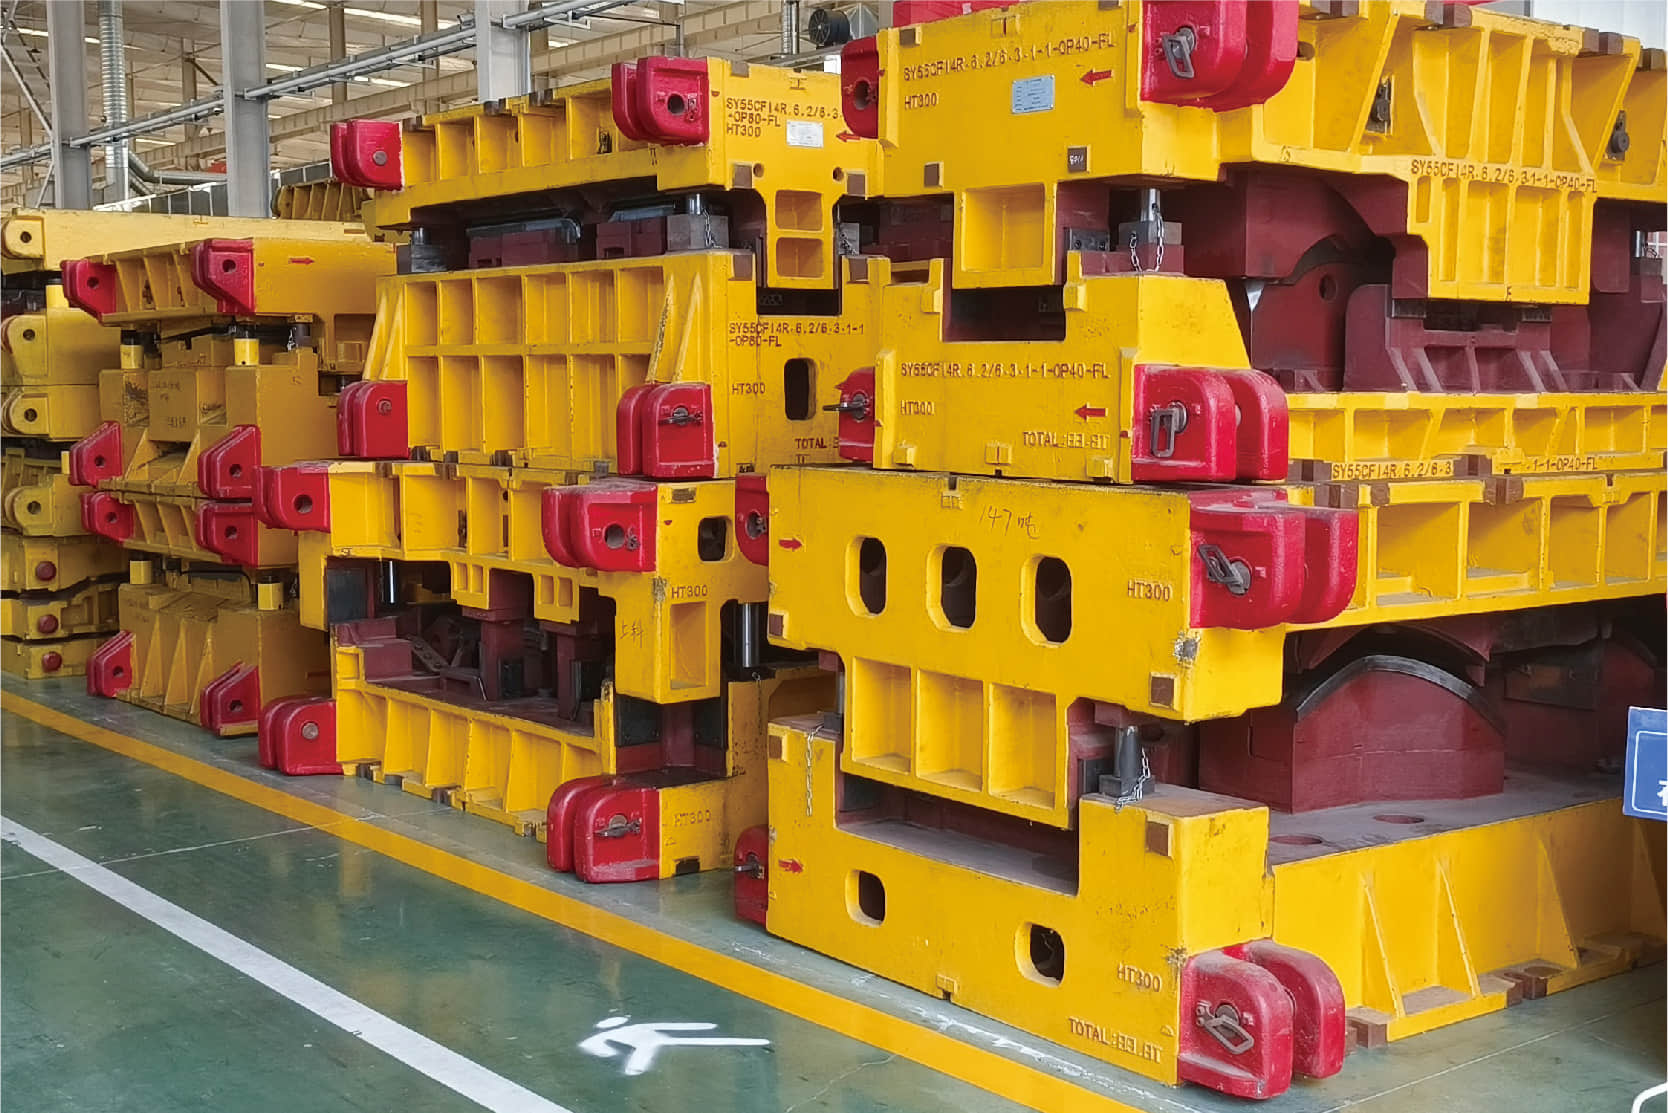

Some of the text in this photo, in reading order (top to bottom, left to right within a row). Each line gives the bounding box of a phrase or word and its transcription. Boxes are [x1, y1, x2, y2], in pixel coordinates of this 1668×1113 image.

[904, 91, 938, 110] HT300
[726, 122, 761, 138] HT300
[732, 382, 766, 395] HT300
[900, 400, 936, 416] HT300
[671, 584, 708, 599] HT300
[1127, 579, 1174, 603] HT300
[674, 809, 712, 828] HT300
[1117, 961, 1162, 993] HT300
